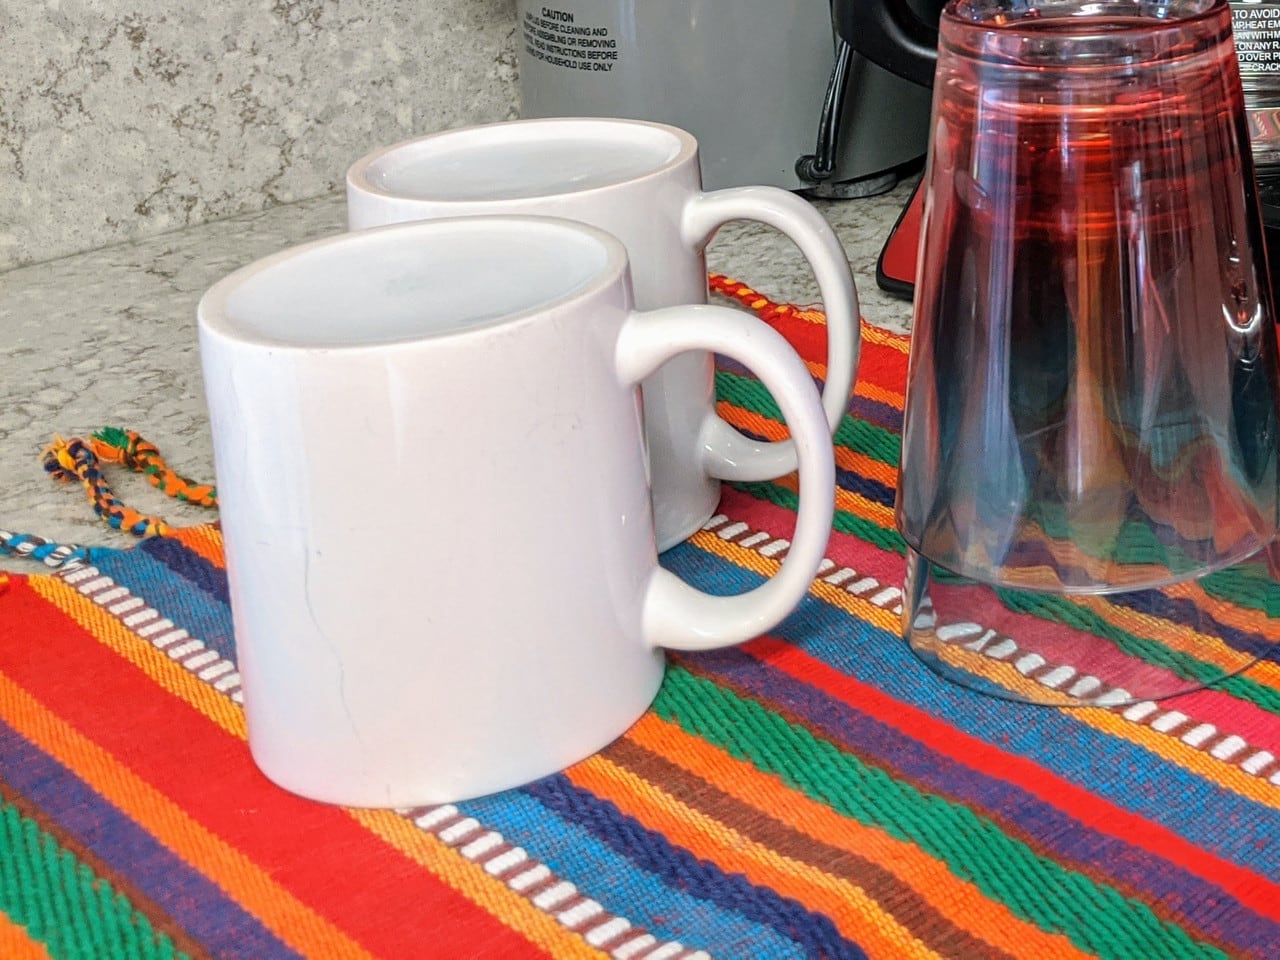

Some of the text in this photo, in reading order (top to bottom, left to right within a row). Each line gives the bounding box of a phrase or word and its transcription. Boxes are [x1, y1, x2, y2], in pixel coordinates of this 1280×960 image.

[541, 7, 574, 23] CAUTION
[1249, 8, 1280, 19] AVOID
[560, 24, 591, 36] CLEANING
[592, 28, 608, 37] AND
[1251, 30, 1274, 39] WITH
[567, 37, 576, 46] OR
[577, 38, 616, 48] REMOVING
[1238, 41, 1252, 50] ON
[1253, 41, 1272, 50] ANY
[587, 50, 618, 60] BEFORE
[1246, 52, 1272, 61] OVER
[578, 61, 592, 71] USE
[593, 62, 613, 72] ONLY
